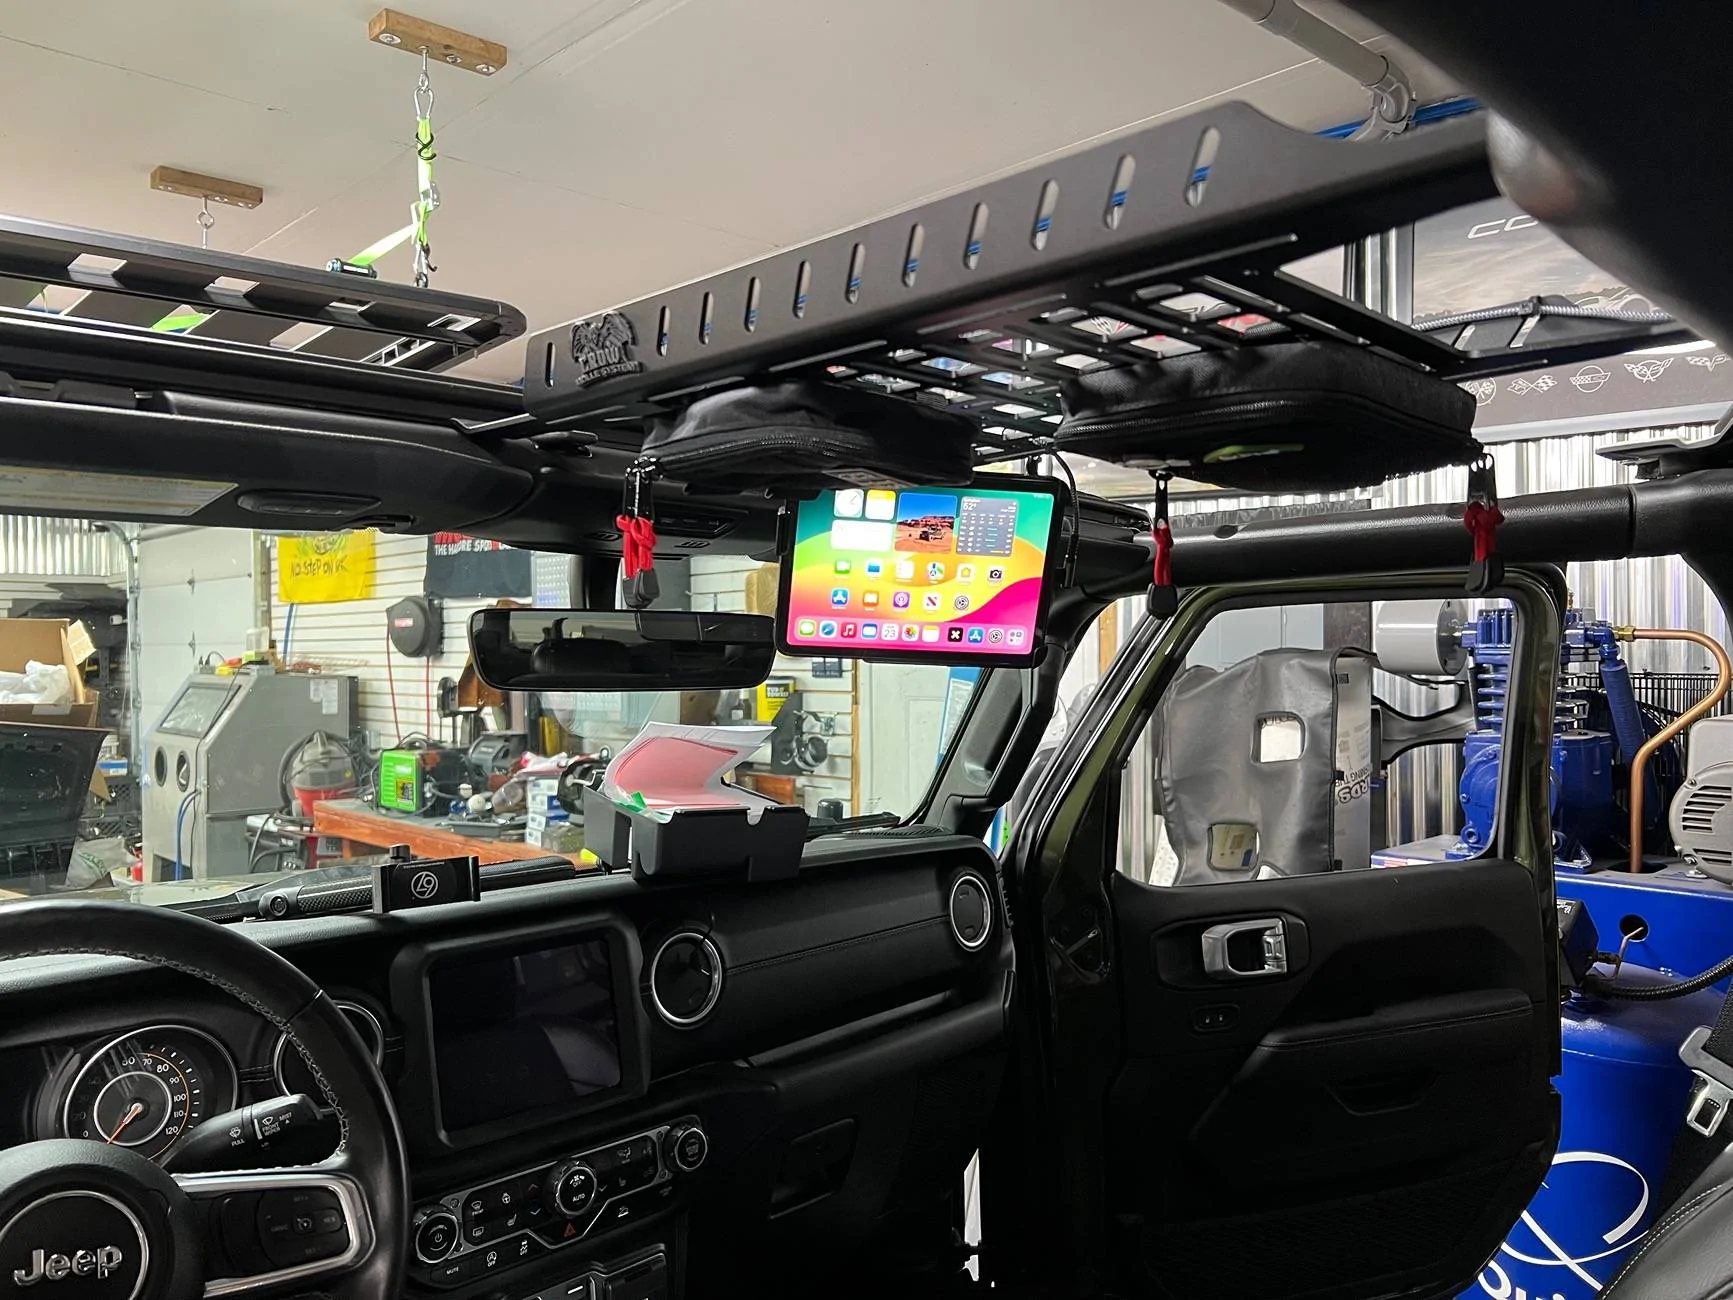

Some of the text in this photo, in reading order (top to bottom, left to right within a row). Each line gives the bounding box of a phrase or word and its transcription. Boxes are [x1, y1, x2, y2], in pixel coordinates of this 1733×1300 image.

[884, 628, 896, 638] 23
[142, 1058, 153, 1066] 70
[156, 1063, 169, 1073] 80
[173, 1093, 186, 1102] 100
[173, 1110, 184, 1118] 110
[165, 1125, 178, 1135] 120
[231, 1138, 246, 1148] PULL
[572, 1193, 586, 1203] AUTO
[13, 1245, 123, 1286] Jeep
[446, 1266, 459, 1275] MUTE
